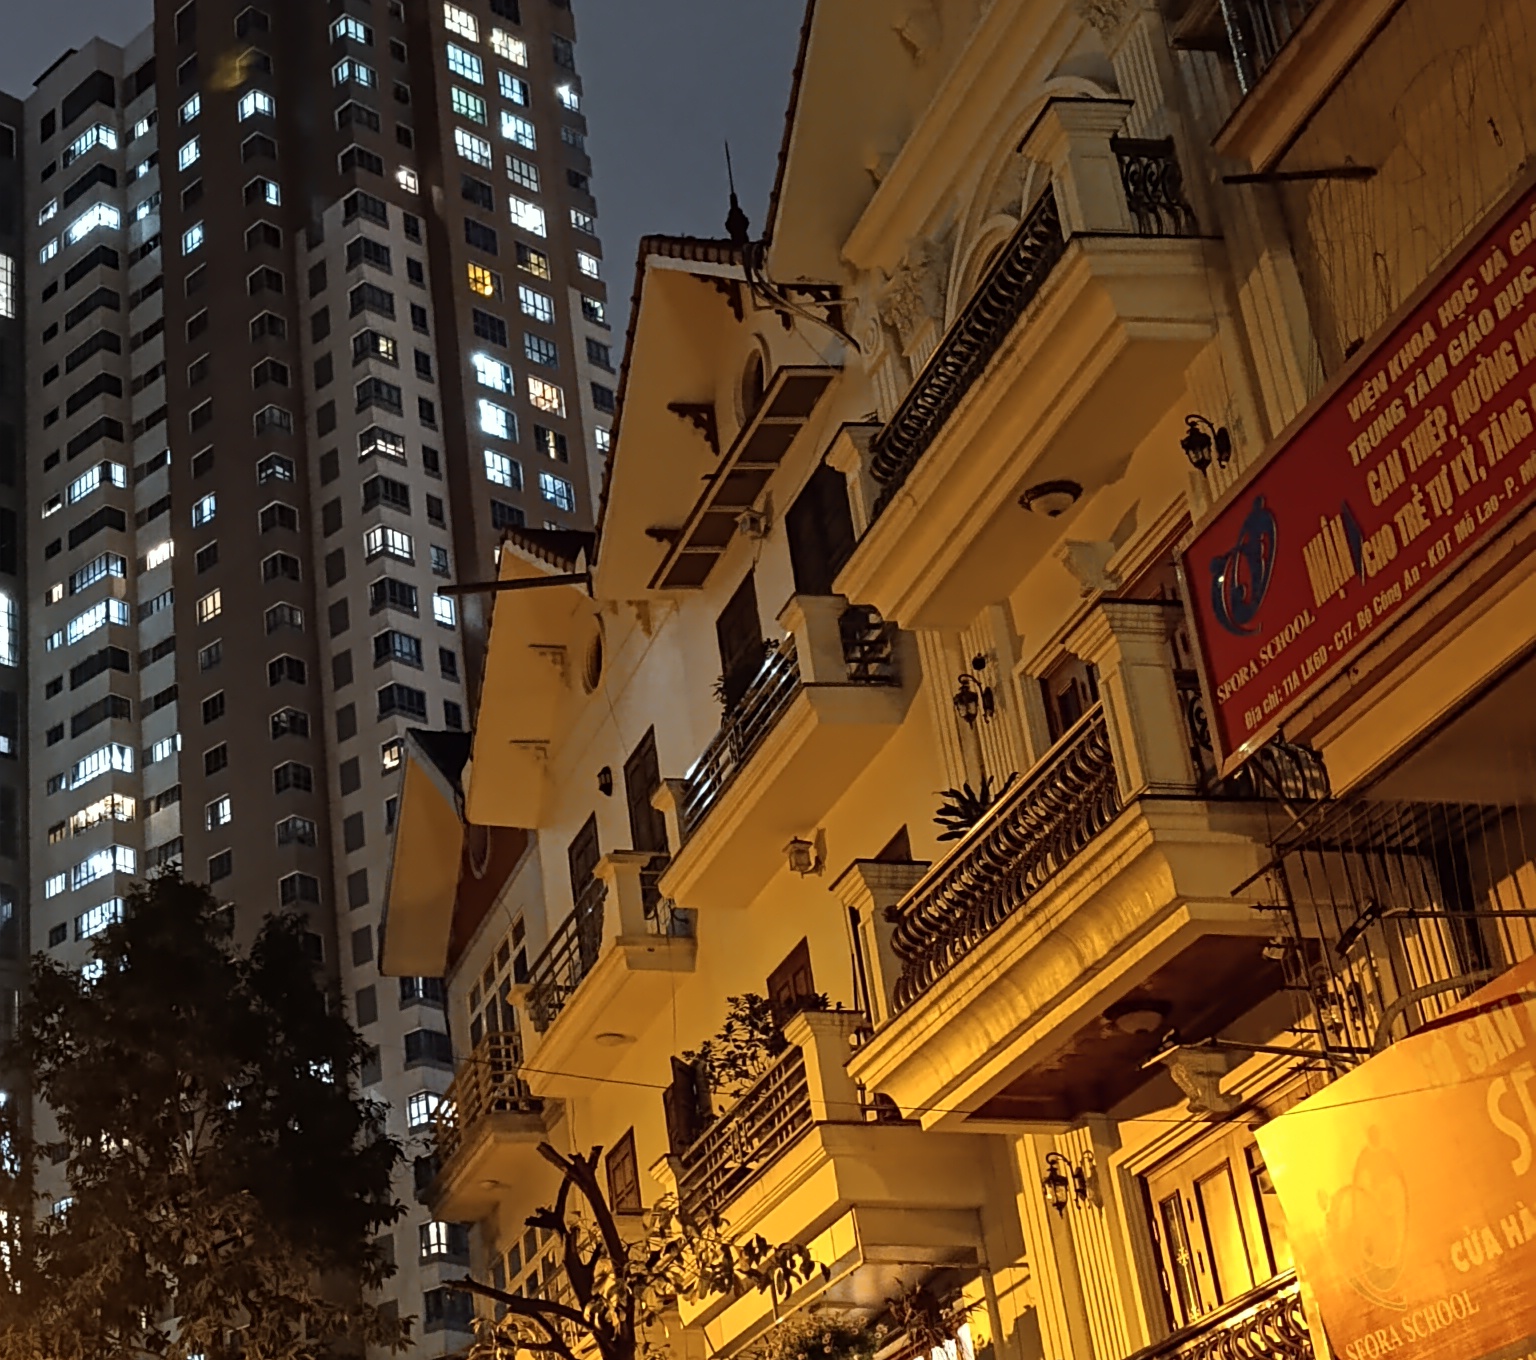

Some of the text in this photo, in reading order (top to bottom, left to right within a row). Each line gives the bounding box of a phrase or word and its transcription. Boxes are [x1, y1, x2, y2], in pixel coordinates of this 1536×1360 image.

[1347, 370, 1388, 422] VIỆN
[1387, 321, 1438, 383] KHOA
[1438, 277, 1479, 329] HỌC
[1348, 266, 1536, 467] TRUNG TÂM GIÁO DỤC
[1363, 523, 1398, 578] CHO
[1394, 483, 1431, 547] TRẺ
[1425, 464, 1453, 518] TỰ
[1478, 398, 1534, 467] TĂNG
[1367, 448, 1406, 507] CAN
[1372, 581, 1402, 616] Công
[1258, 608, 1316, 668] SCHOOL
[1401, 1288, 1480, 1343] SCHOOL
